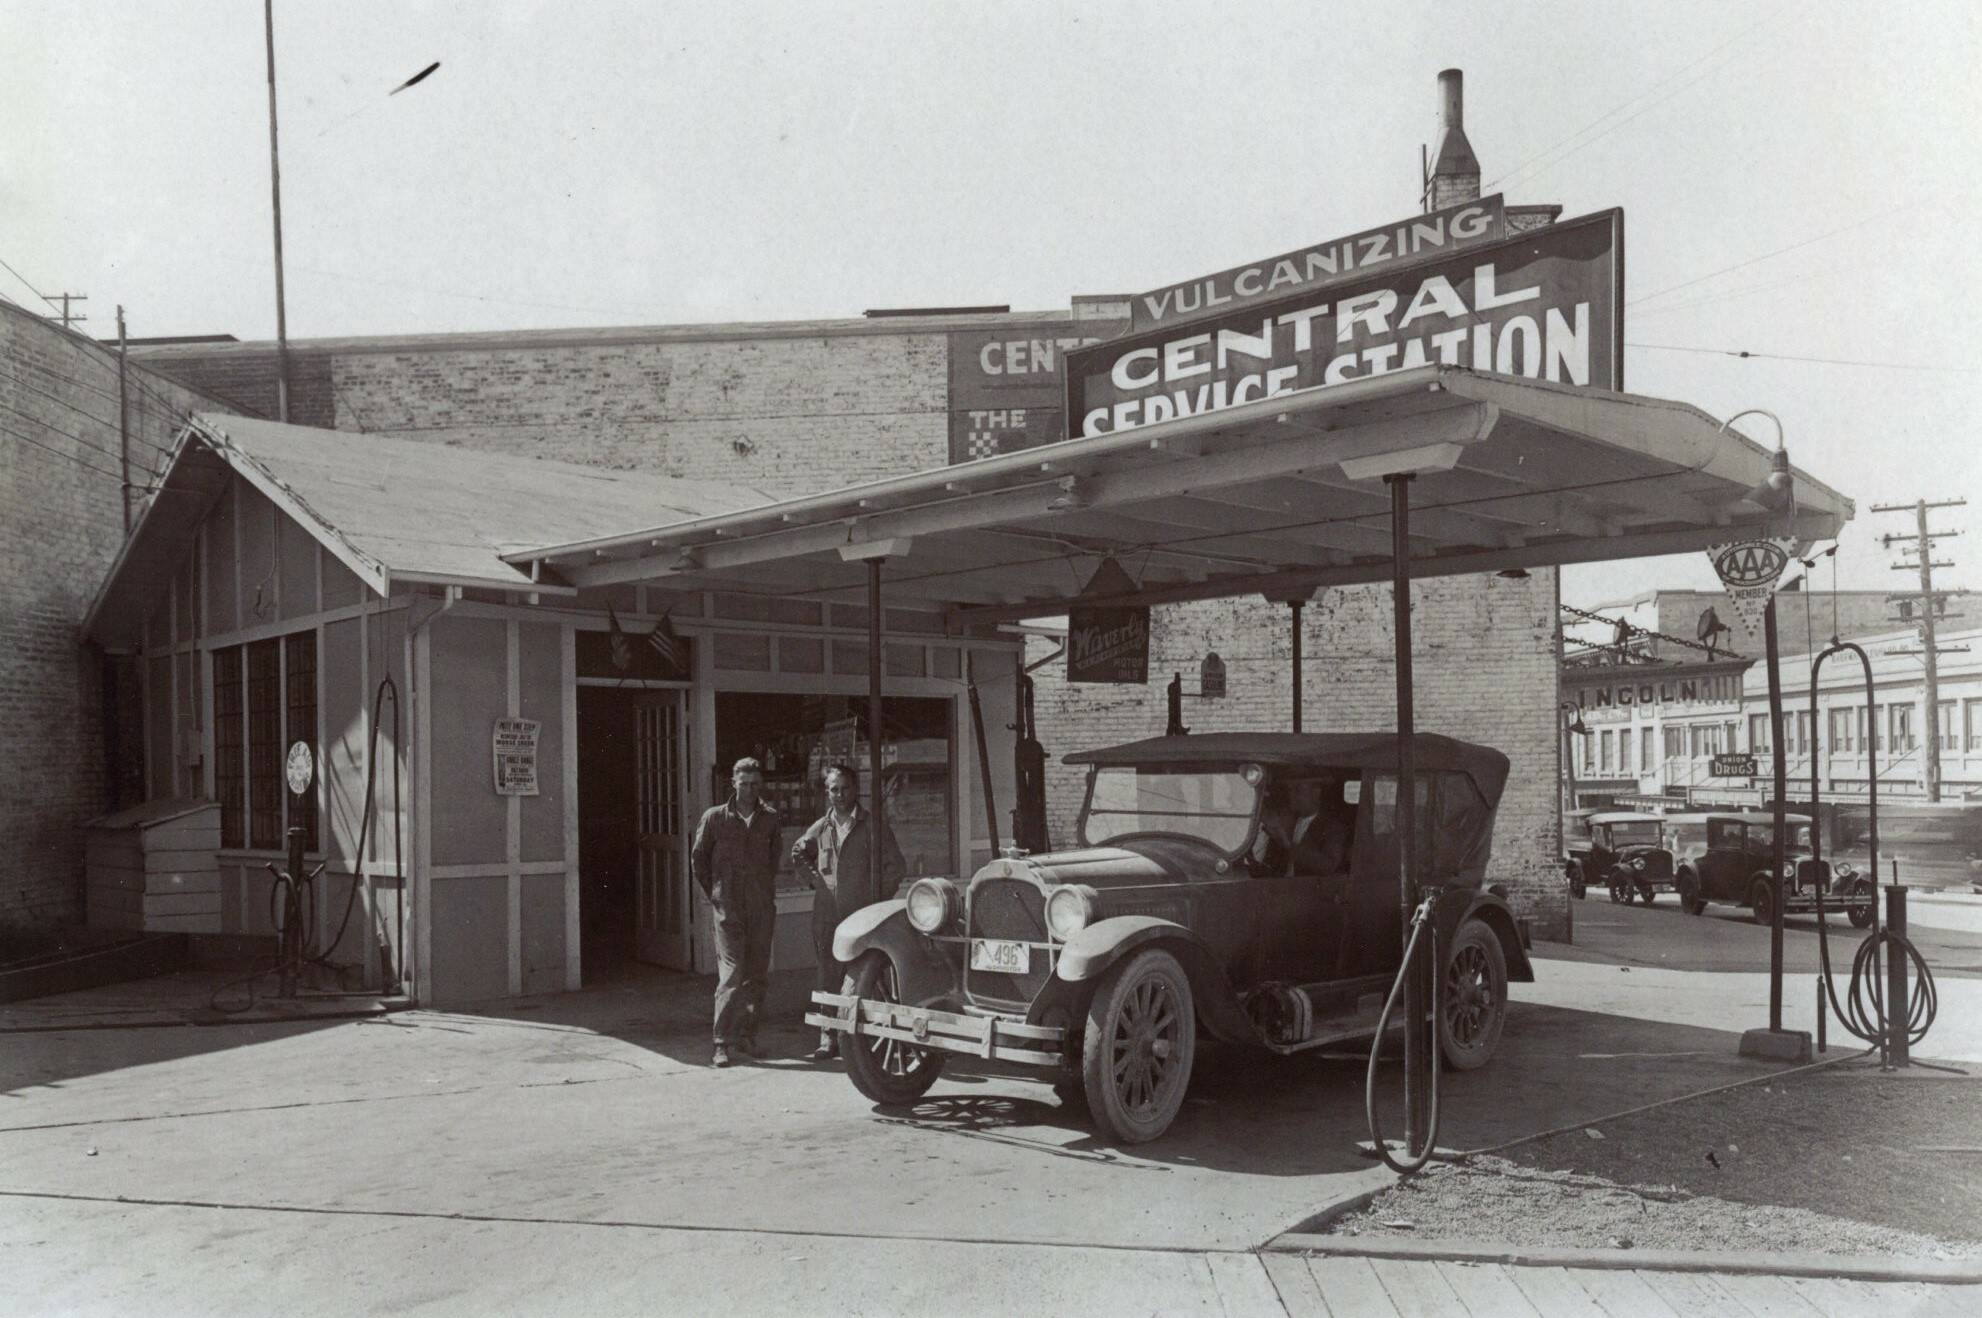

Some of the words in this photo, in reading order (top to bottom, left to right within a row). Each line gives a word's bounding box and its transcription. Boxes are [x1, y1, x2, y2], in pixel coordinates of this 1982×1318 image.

[1144, 206, 1494, 321] VULCANIZING
[1111, 263, 1541, 391] CENTRAL
[1324, 302, 1590, 387] STATION
[968, 409, 1027, 430] THE
[1727, 547, 1775, 580] AAA
[1735, 587, 1768, 599] MEMBER
[1579, 680, 1697, 709] INCOLN
[1715, 761, 1754, 775] DRUGS
[1722, 755, 1747, 764] UNION
